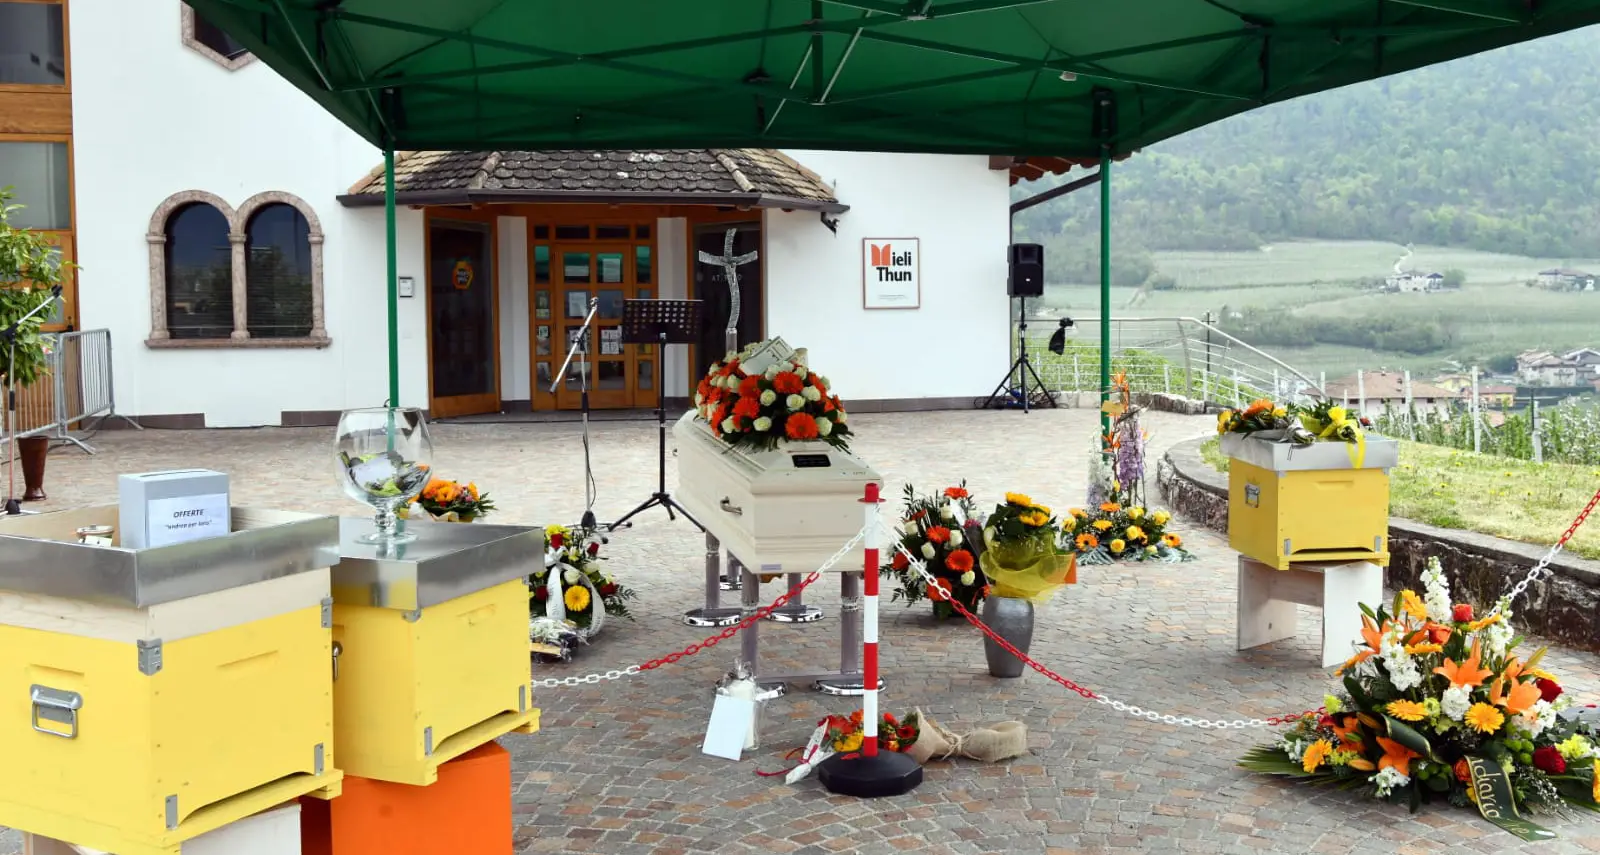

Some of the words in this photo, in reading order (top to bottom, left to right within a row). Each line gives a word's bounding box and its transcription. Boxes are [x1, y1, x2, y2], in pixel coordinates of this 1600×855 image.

[871, 244, 912, 266] Mieli
[876, 267, 912, 282] Thun
[173, 509, 204, 518] OFFERTE
